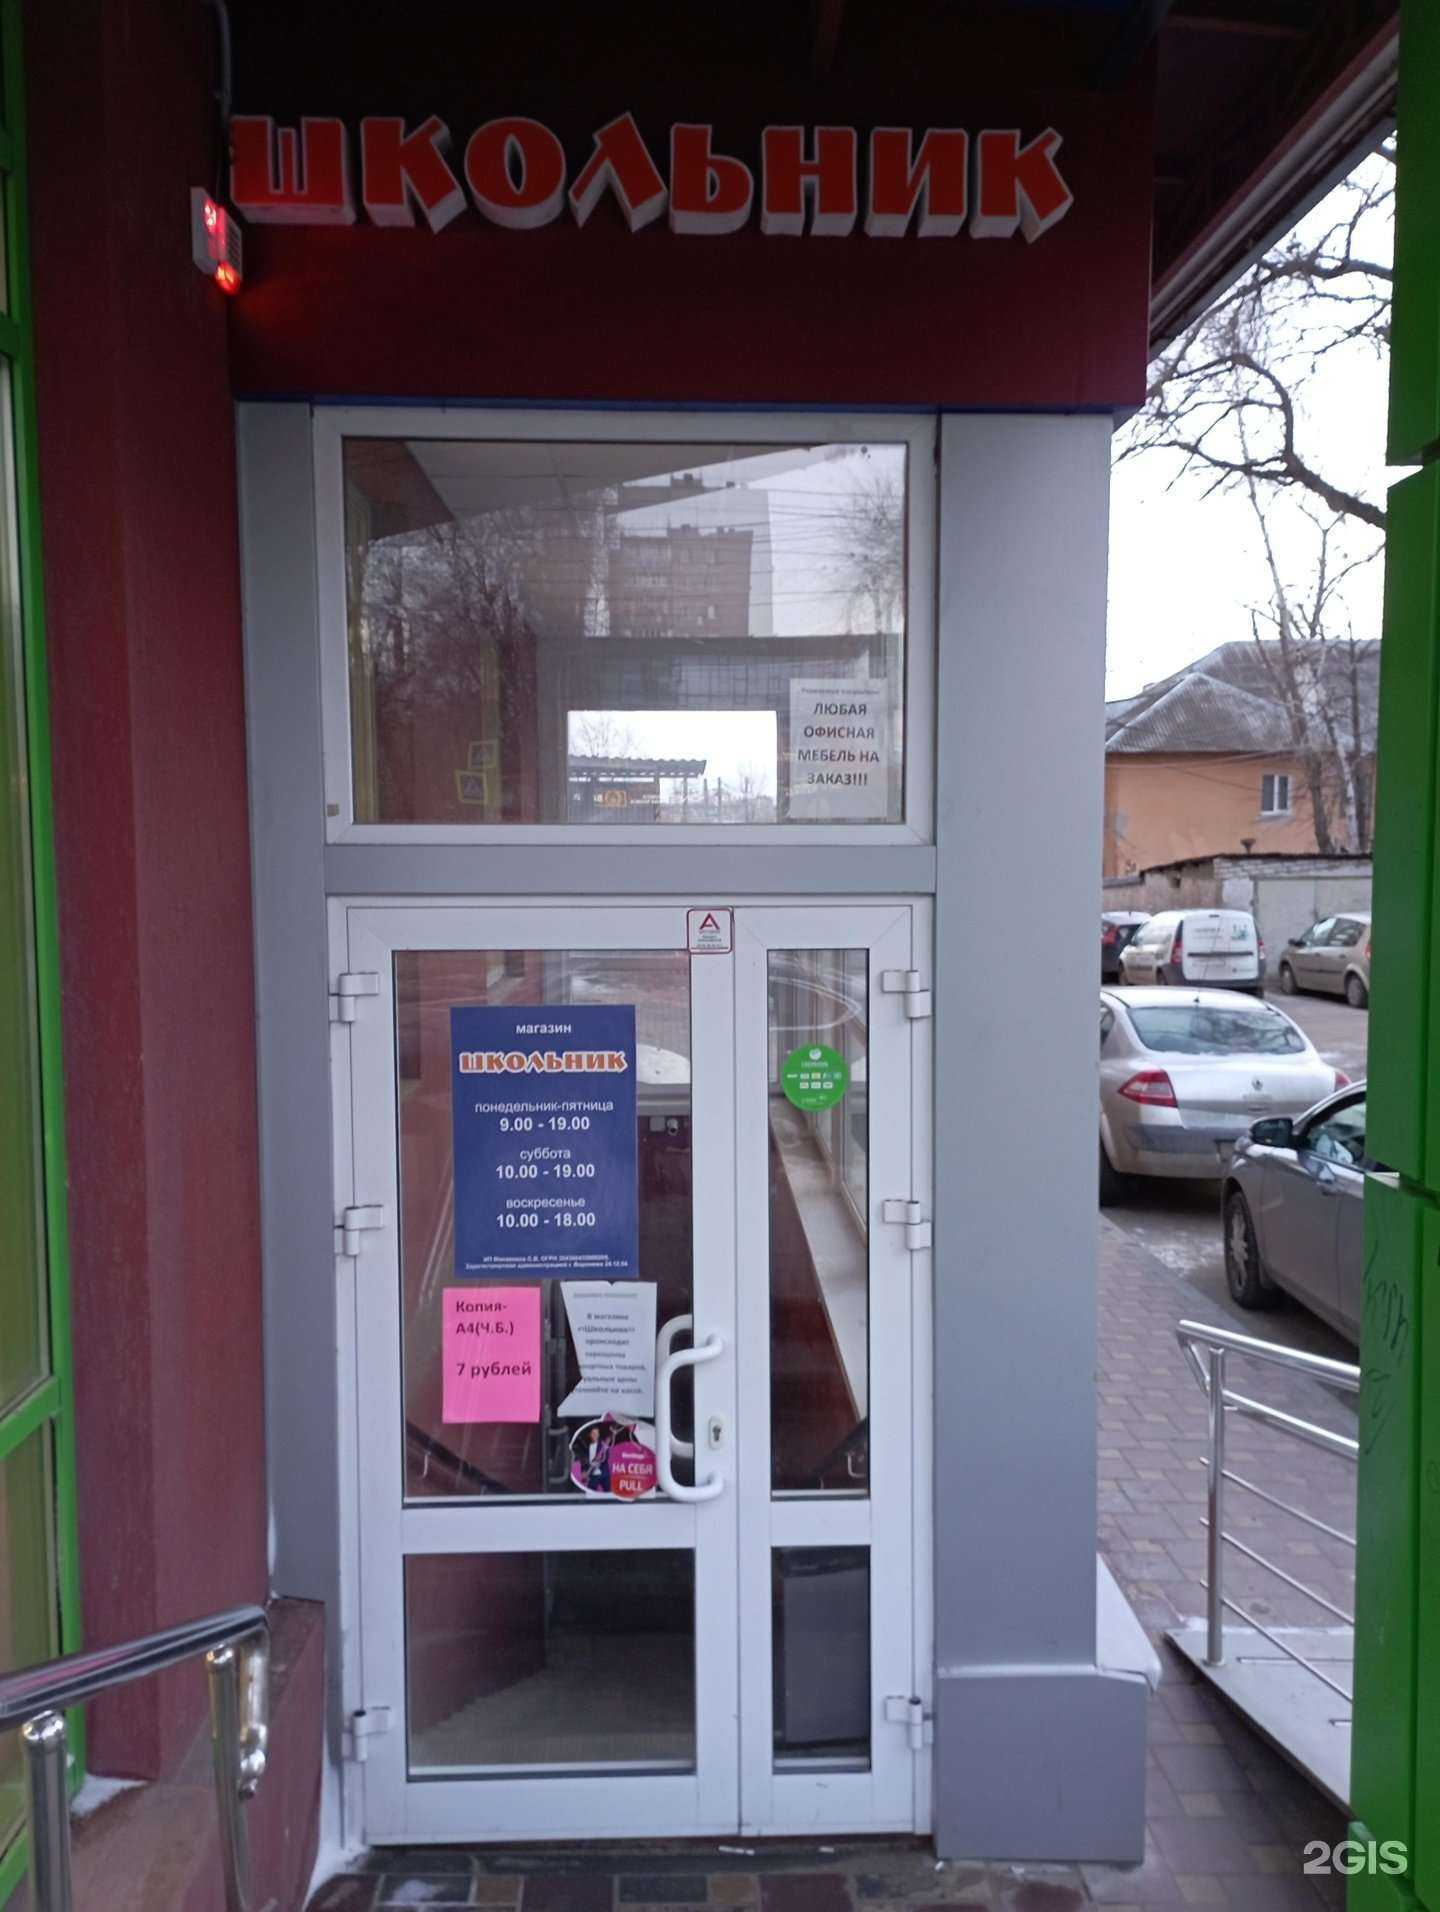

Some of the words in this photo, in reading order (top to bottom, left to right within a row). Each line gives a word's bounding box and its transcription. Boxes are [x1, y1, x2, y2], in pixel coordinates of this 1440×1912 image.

[229, 111, 1074, 243] ШКОЛЬНИК
[813, 702, 867, 716] ЛЮБАЯ
[803, 725, 875, 739] ОФИСНАЯ
[798, 749, 856, 763] МЕБЕЛЬ
[859, 751, 880, 763] НА
[807, 772, 868, 786] ЗАКАЗ!!!
[515, 1023, 572, 1035] магазин
[459, 1050, 629, 1074] ШКОЛЬНИК
[474, 1100, 614, 1114] понедельник-пятница
[499, 1117, 533, 1131] 9.00
[548, 1116, 590, 1130] 19.00
[519, 1147, 571, 1162] суббота
[495, 1165, 539, 1179] 10.00
[552, 1164, 595, 1178] 19.00
[505, 1197, 586, 1209] воскресенье
[496, 1213, 539, 1228] 10.00
[553, 1212, 596, 1227] 18.00
[455, 1301, 507, 1313] Копия-
[455, 1320, 515, 1336] А4(Ч.Б.)
[456, 1362, 465, 1375] 7
[470, 1360, 532, 1379] рублей
[612, 1463, 626, 1474] НА
[628, 1463, 653, 1475] СЕБЯ
[619, 1479, 643, 1491] PULL
